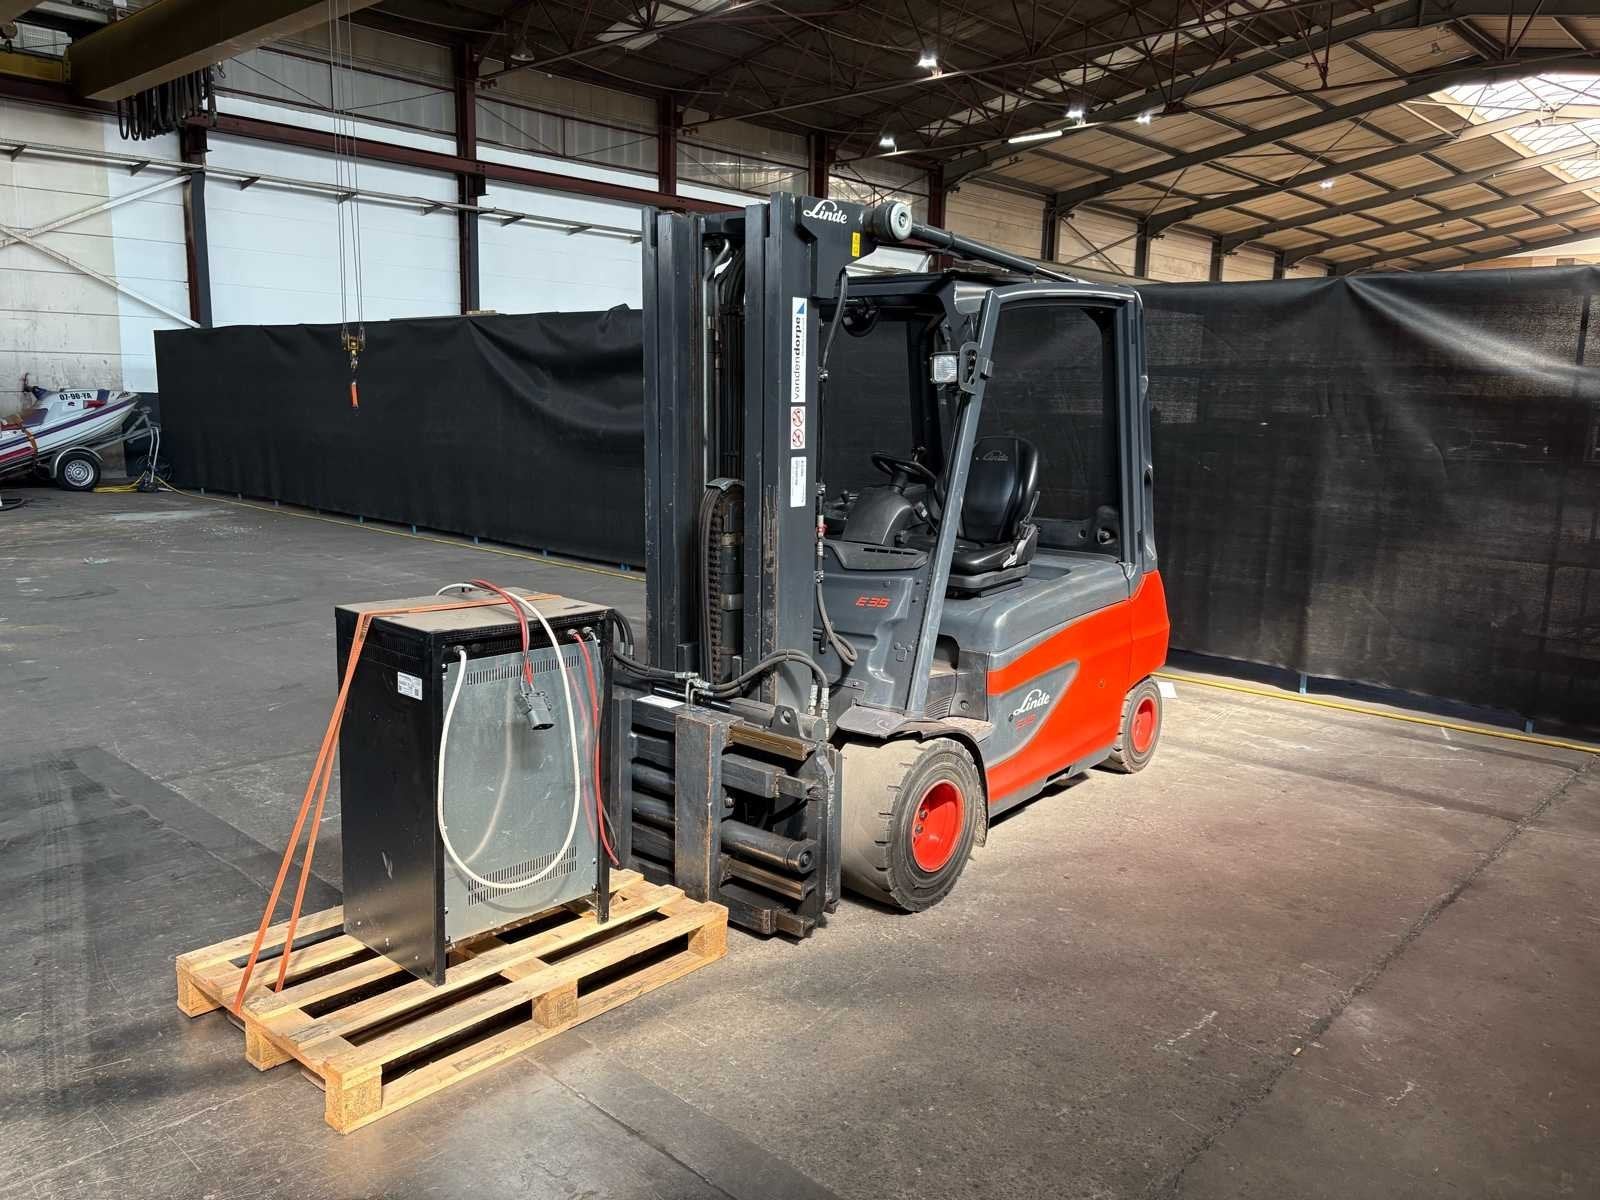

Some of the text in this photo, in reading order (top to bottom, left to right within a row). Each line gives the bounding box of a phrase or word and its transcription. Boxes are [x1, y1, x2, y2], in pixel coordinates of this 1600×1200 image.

[803, 200, 848, 224] Linde
[793, 317, 802, 400] vandendorpe
[1013, 689, 1050, 716] Linde
